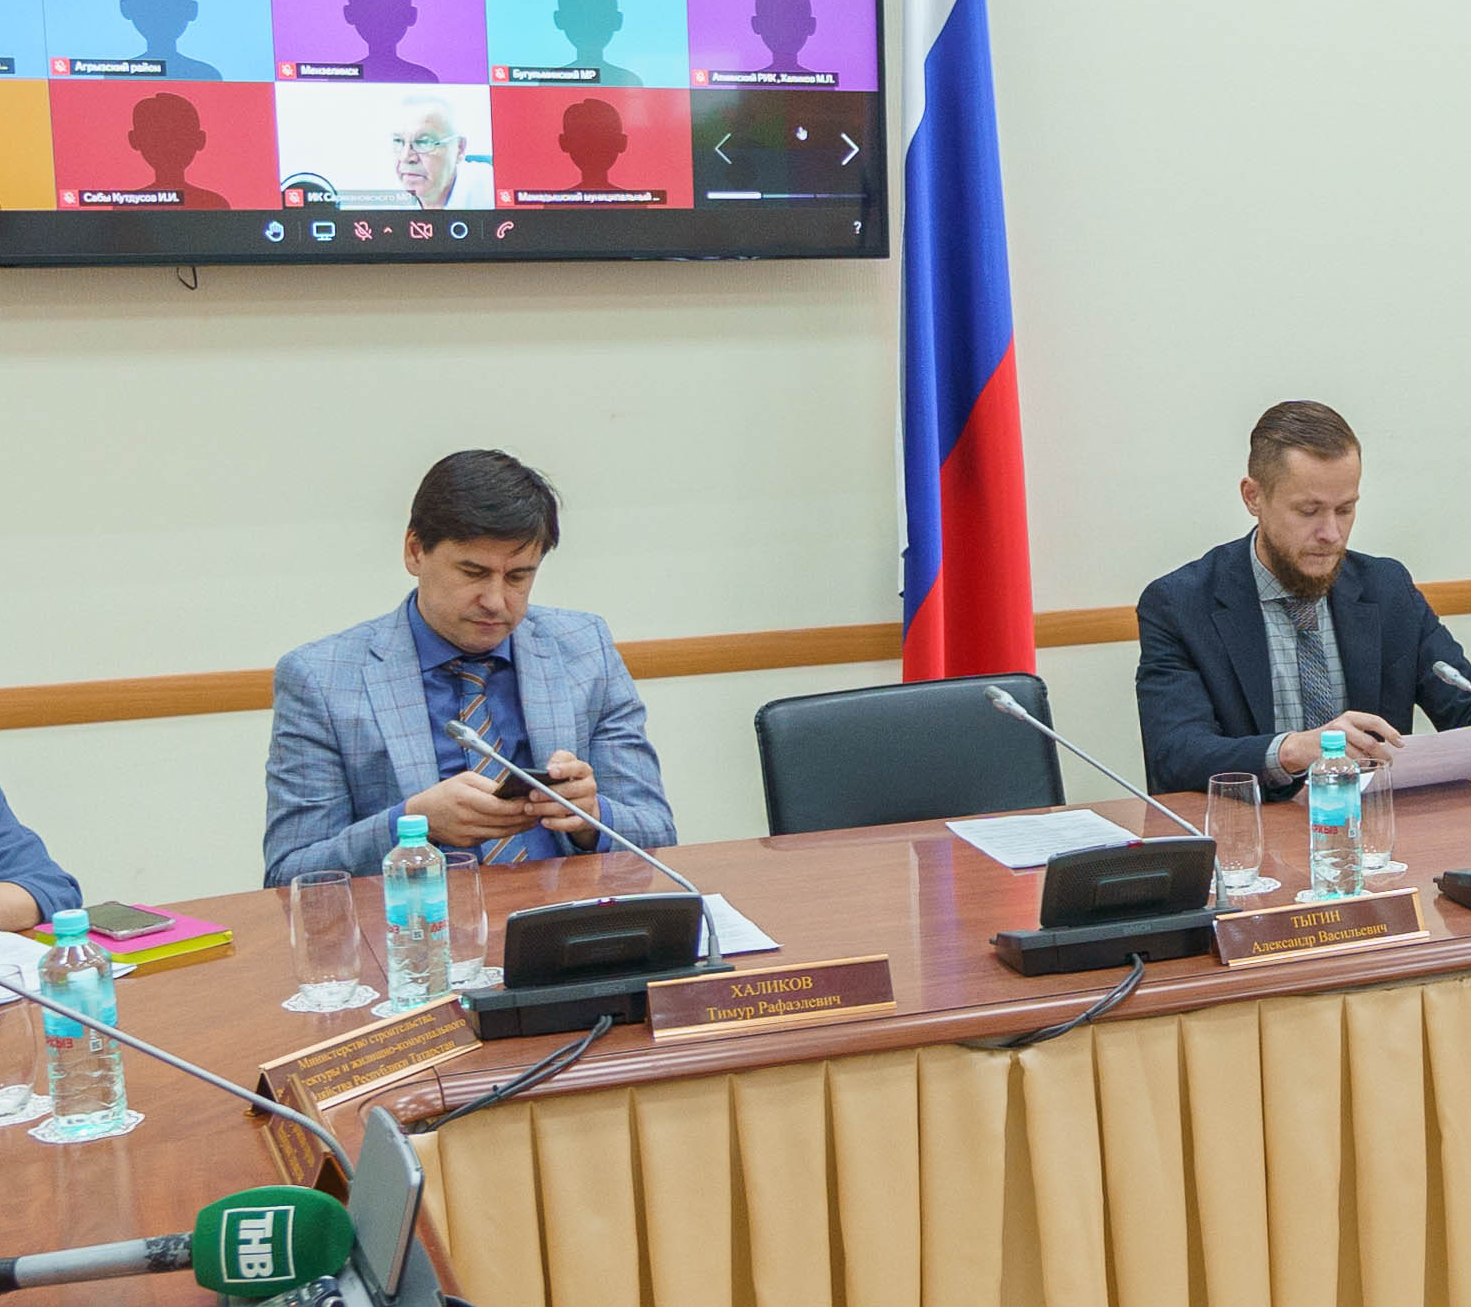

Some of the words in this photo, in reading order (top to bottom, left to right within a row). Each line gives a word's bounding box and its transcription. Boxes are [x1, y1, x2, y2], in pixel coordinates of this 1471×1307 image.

[75, 61, 129, 74] Агрызский
[130, 63, 161, 74] район
[83, 192, 111, 203] Сабы
[1290, 909, 1341, 929] ТЫГИН
[1251, 934, 1316, 955] Александр
[1318, 922, 1388, 944] Васильевич
[731, 976, 813, 998] ХАЛИКОВ
[706, 1006, 755, 1022] Тимур
[758, 994, 842, 1015] Рафаэлевич
[297, 1036, 368, 1070] Министерство
[239, 1211, 275, 1278] ТНВ
